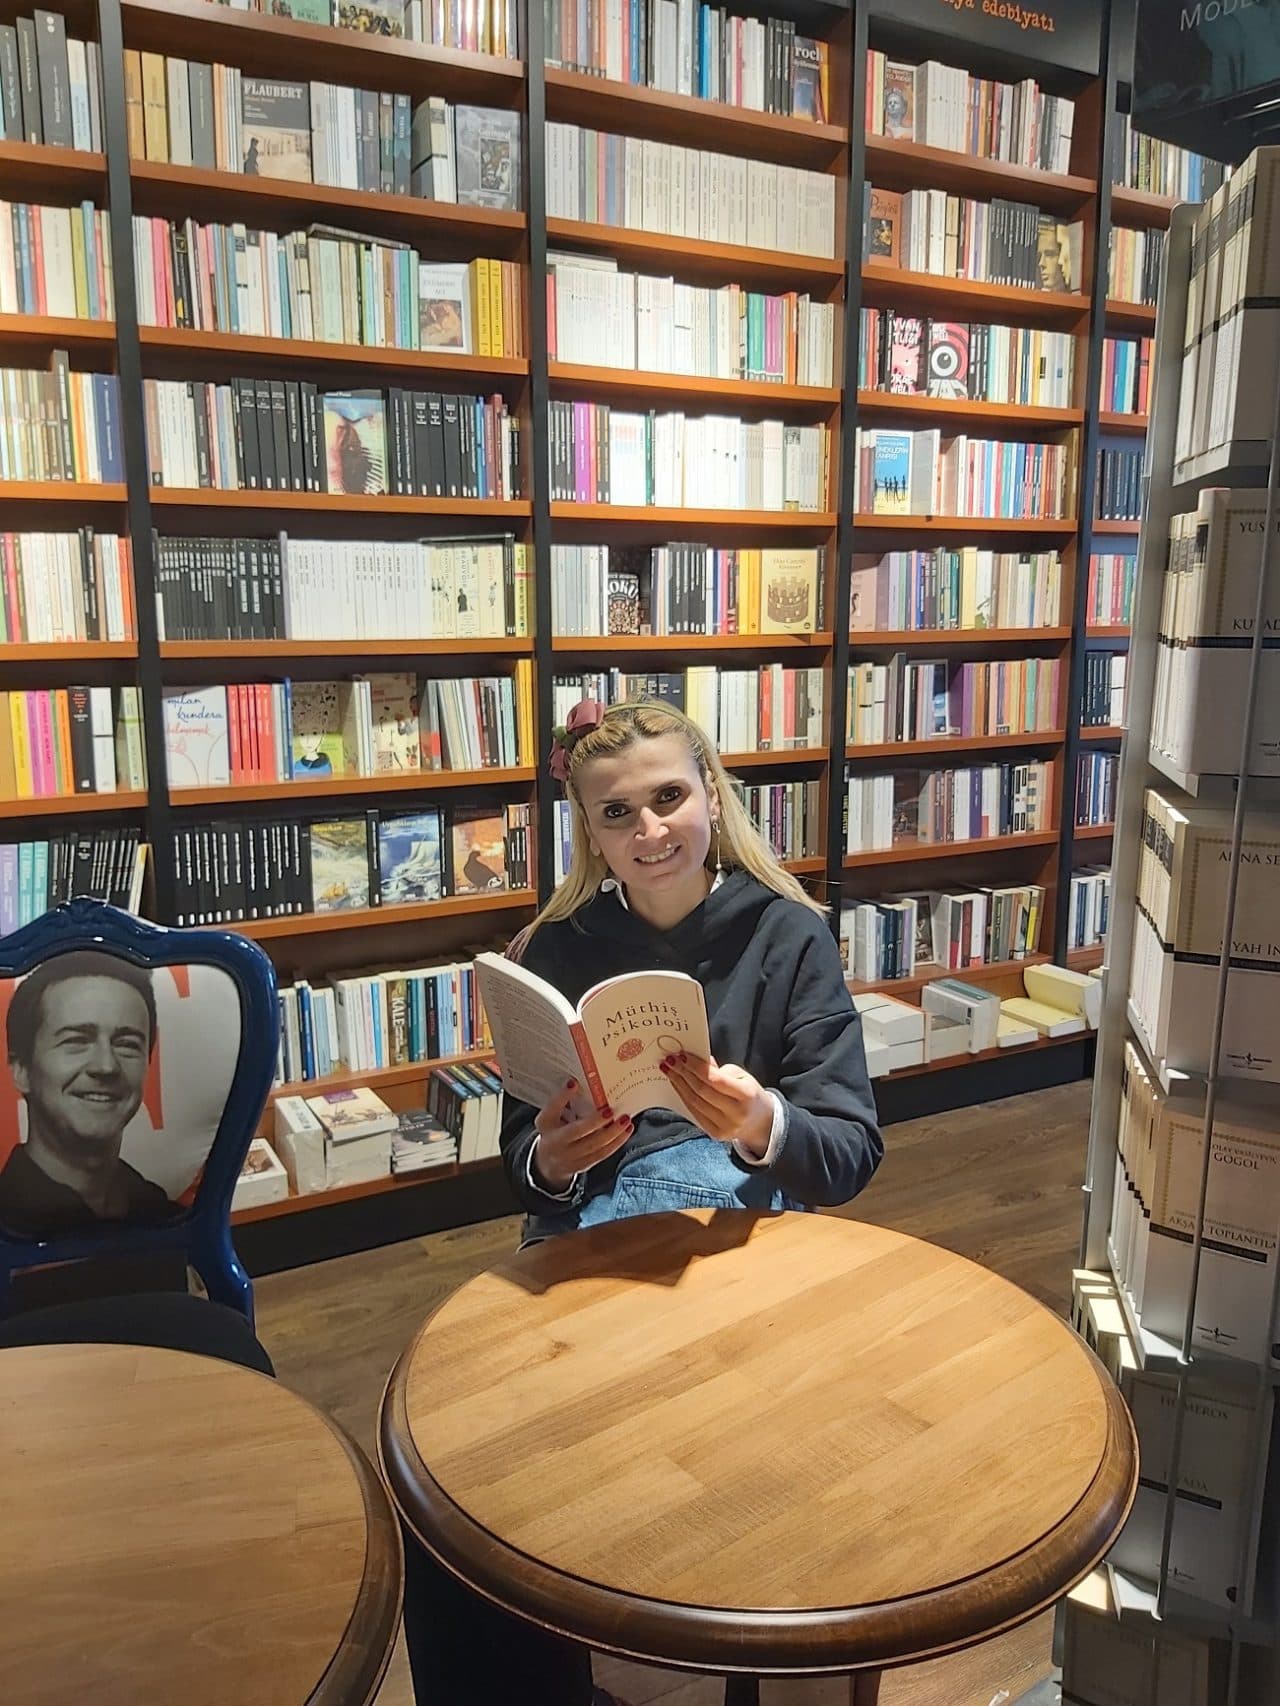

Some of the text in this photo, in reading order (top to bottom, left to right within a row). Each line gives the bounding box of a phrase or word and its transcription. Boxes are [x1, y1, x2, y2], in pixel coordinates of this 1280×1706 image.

[982, 1, 1056, 33] edebiyatı
[244, 80, 303, 100] FLAUBERT
[176, 706, 224, 724] kundera
[1220, 940, 1261, 955] YAH
[605, 1001, 678, 1028] Müthiş
[1213, 1152, 1259, 1170] GOGOL
